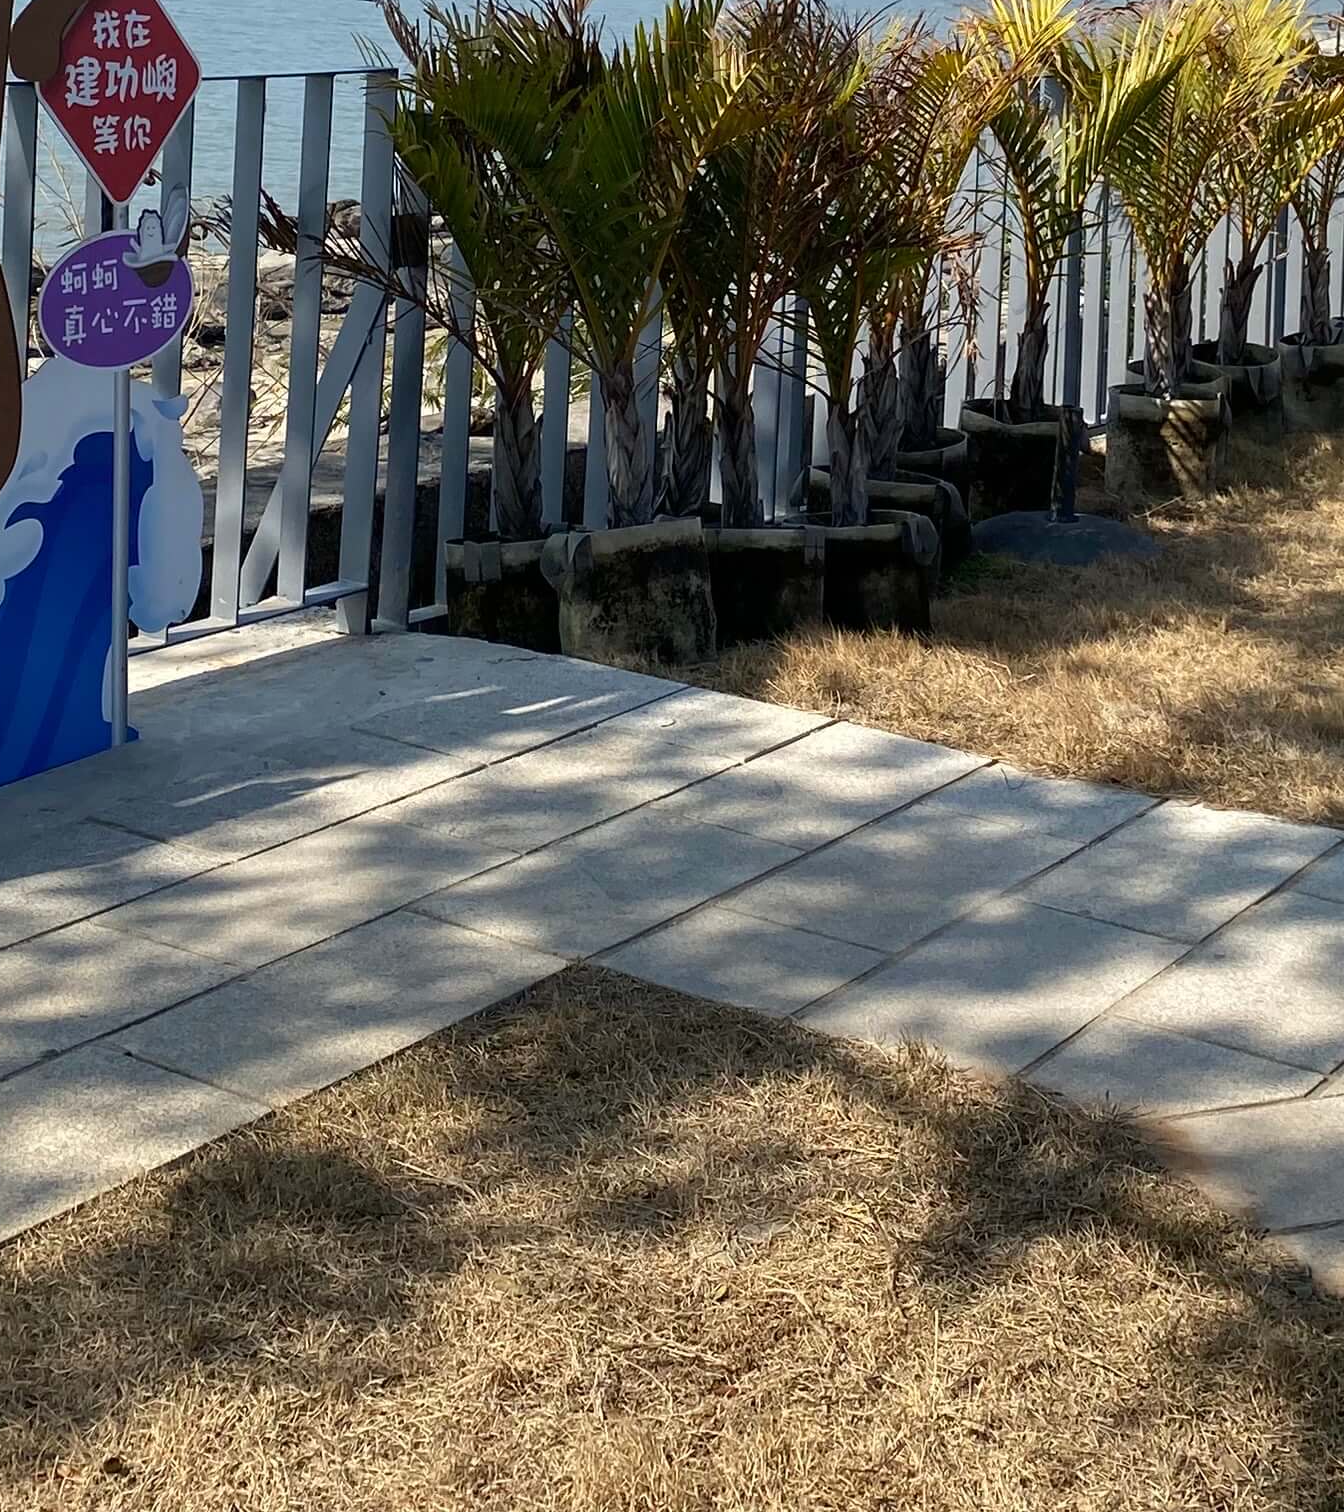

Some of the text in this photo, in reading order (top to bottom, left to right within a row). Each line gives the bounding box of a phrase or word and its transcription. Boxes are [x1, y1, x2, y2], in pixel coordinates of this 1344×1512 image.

[92, 9, 151, 49] 我在
[65, 53, 177, 108] 建功嶼
[93, 114, 151, 155] 等你
[61, 259, 118, 295] 蚵蚵
[62, 293, 177, 347] 真心不錯
